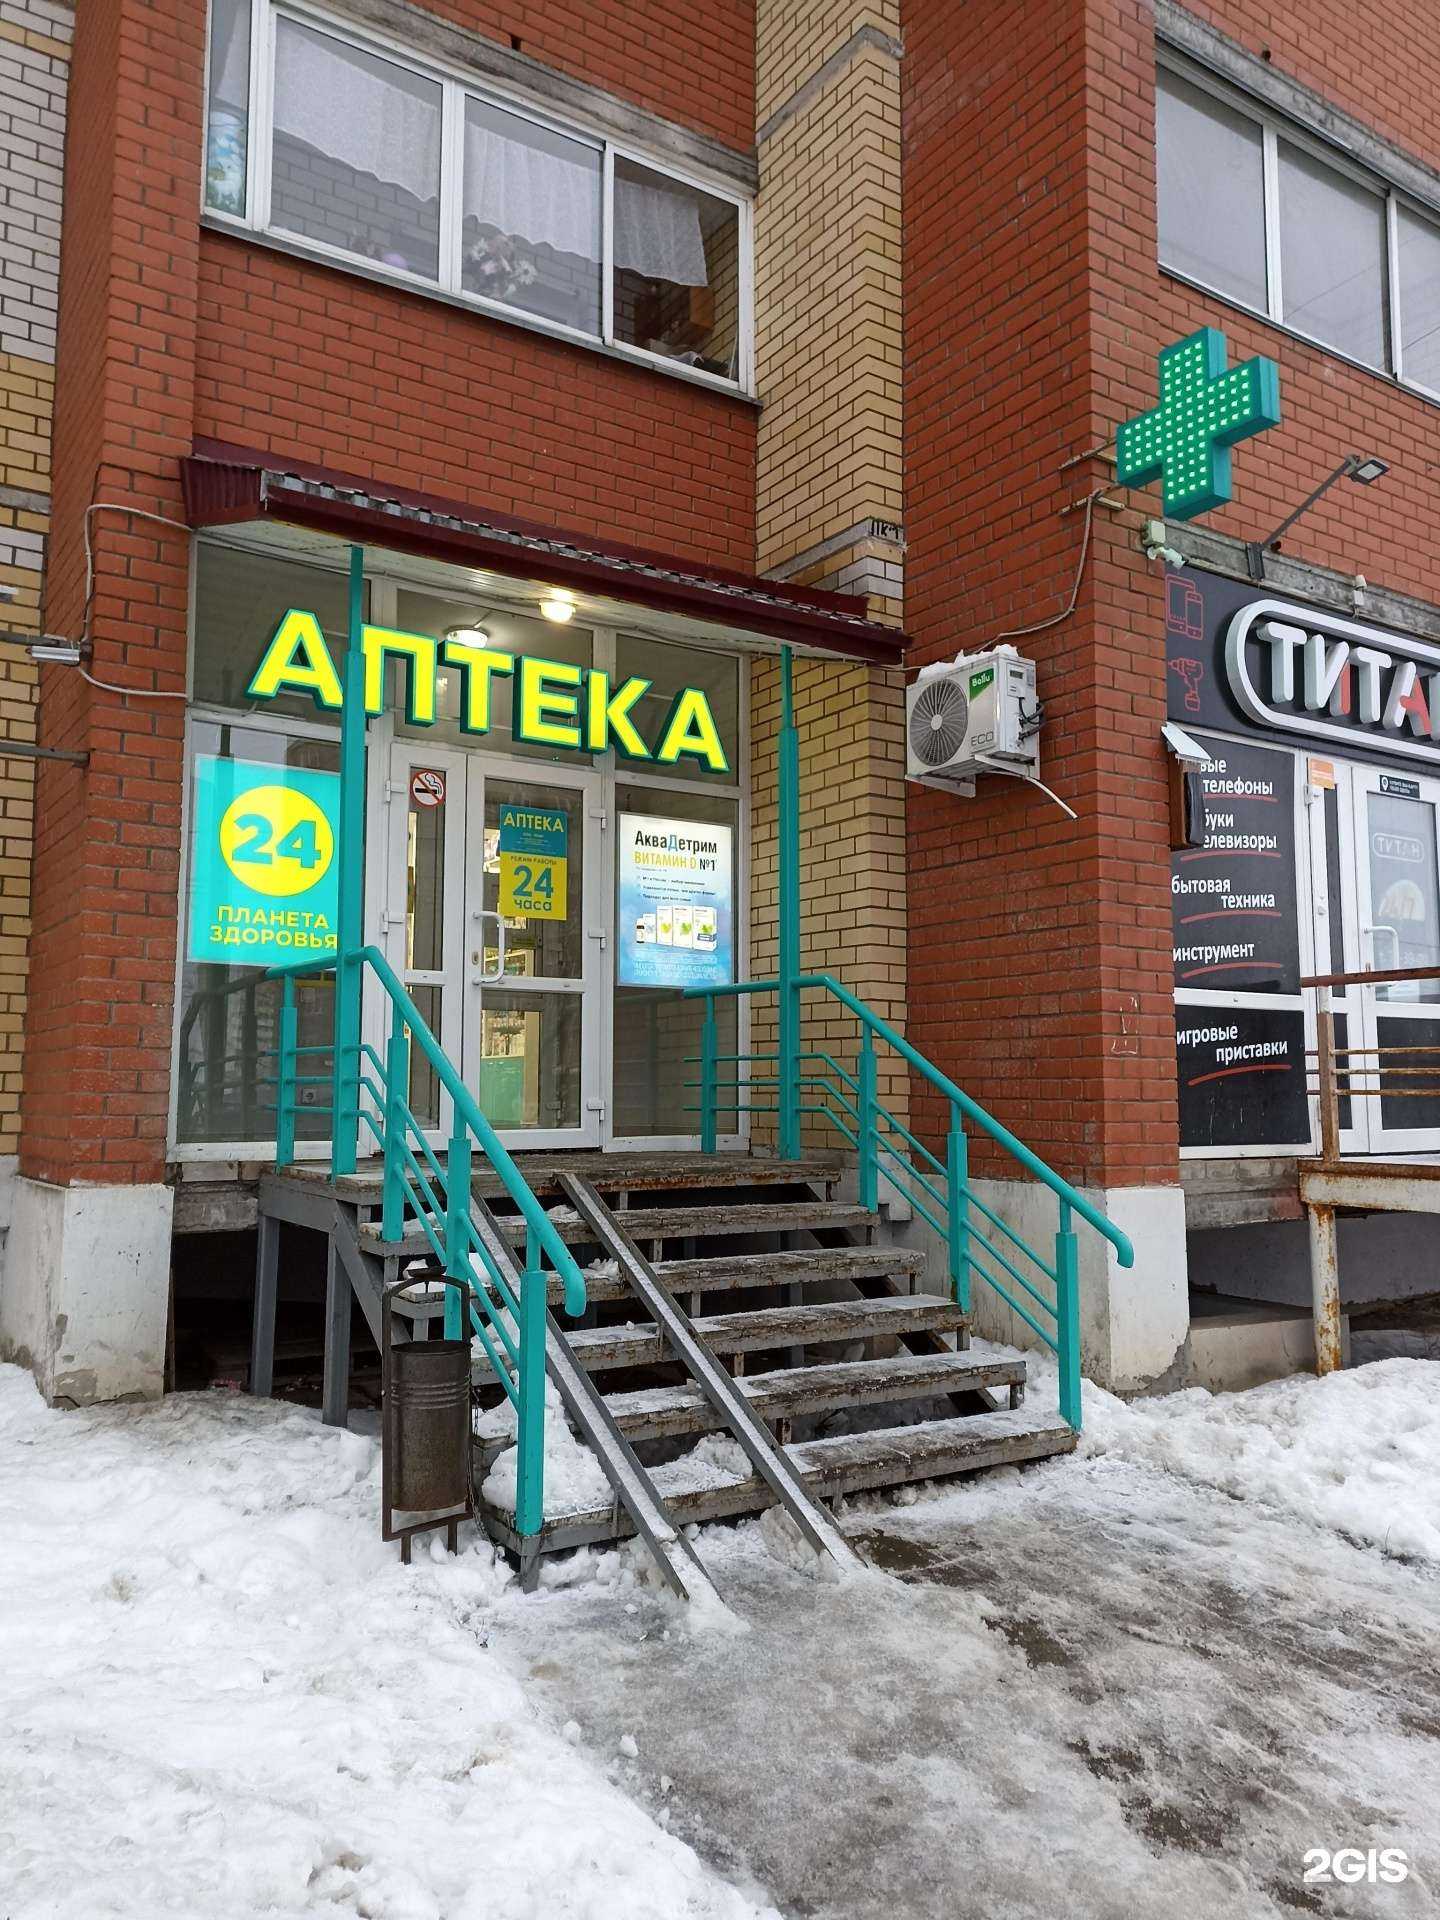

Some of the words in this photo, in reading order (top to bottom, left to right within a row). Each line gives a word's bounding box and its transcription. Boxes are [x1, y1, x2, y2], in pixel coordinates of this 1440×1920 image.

[244, 608, 730, 774] АПТЕКА
[1256, 621, 1440, 741] ТИТА
[971, 731, 994, 746] ECO
[1202, 776, 1273, 795] телефоны
[503, 811, 565, 833] АПТЕКА
[231, 813, 322, 869] 24
[634, 829, 718, 854] АкваДетрим
[1202, 834, 1277, 853] елевизоры
[634, 850, 687, 868] ВИТАМИН
[512, 864, 554, 898] 24
[1171, 875, 1231, 894] бытовая
[514, 899, 552, 912] часа
[1220, 893, 1276, 909] техника
[217, 905, 330, 930] ПЛАНЕТА
[209, 925, 338, 950] ЗДОРОВЬЯ
[1172, 943, 1255, 964] инструмент
[1176, 1025, 1239, 1048] игровые
[1216, 1040, 1288, 1065] приставки
